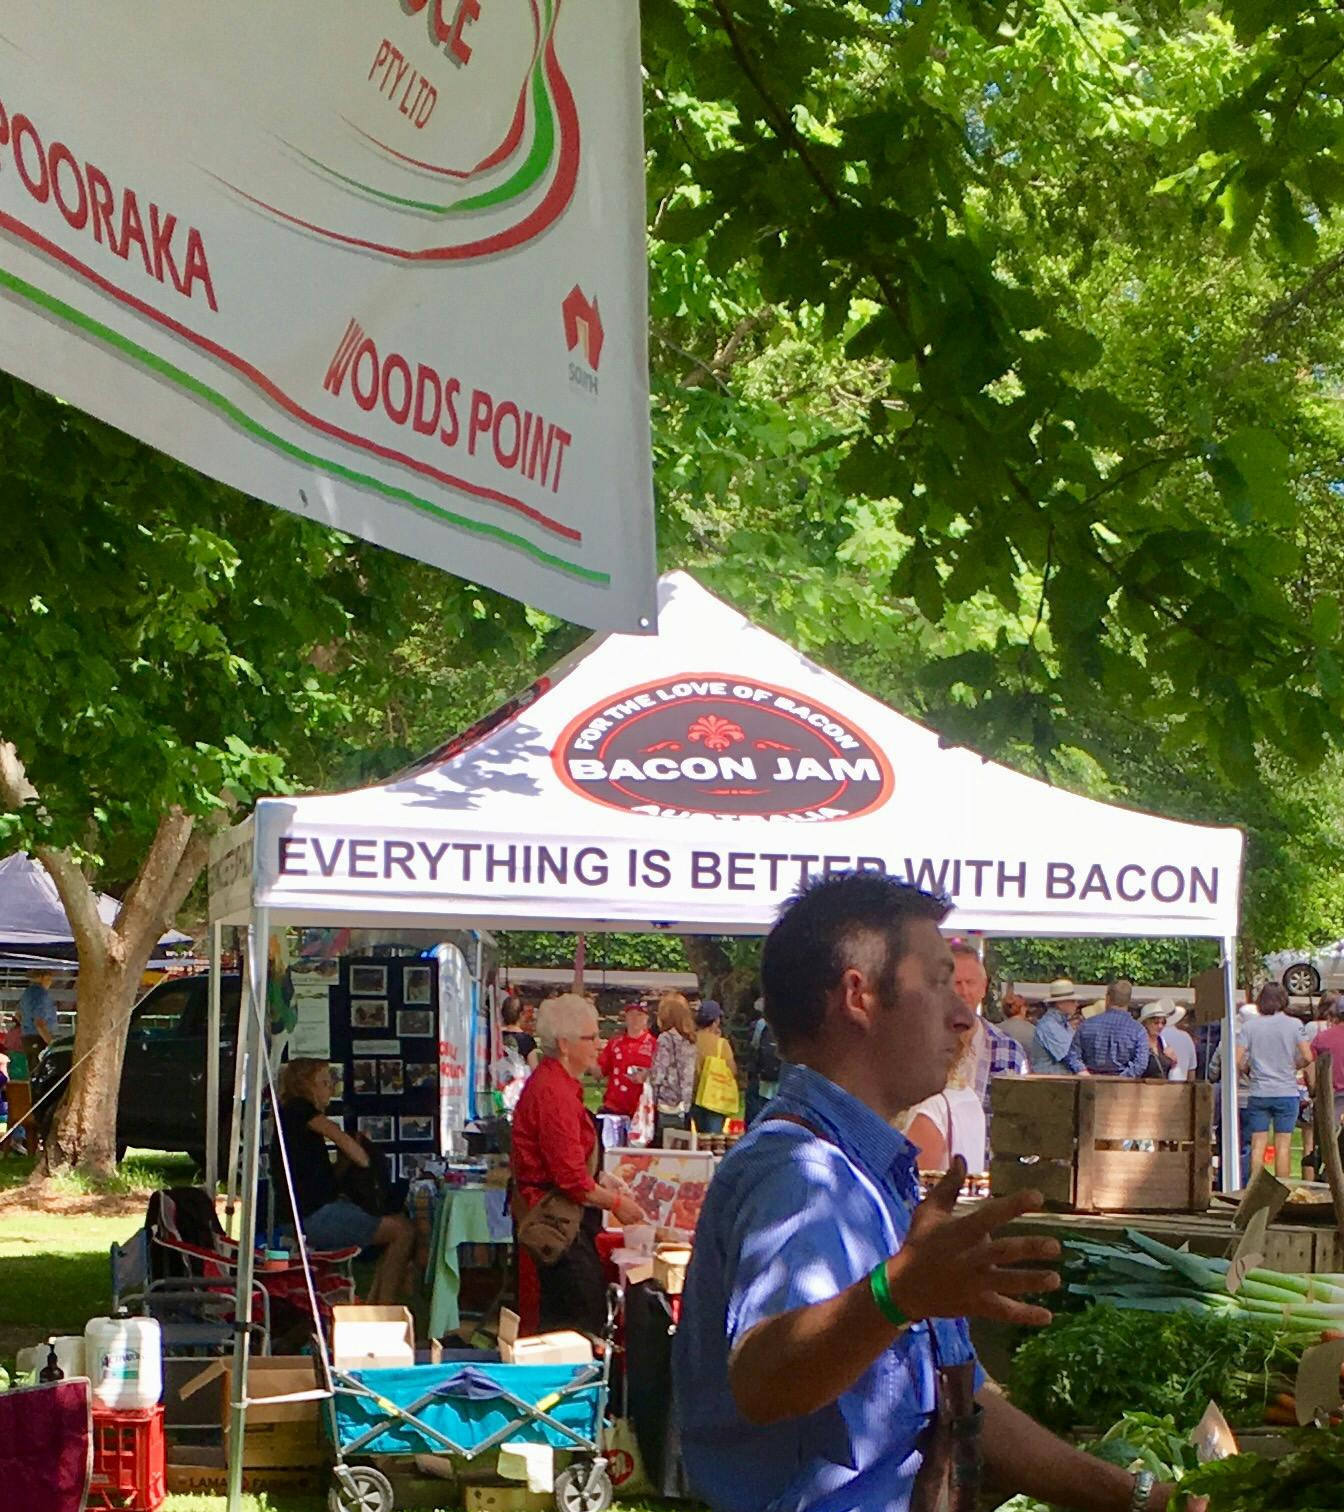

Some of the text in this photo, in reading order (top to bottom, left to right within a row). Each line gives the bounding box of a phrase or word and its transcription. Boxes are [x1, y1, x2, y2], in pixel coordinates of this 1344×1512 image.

[368, 38, 438, 129] PTY LTD
[324, 316, 572, 494] WOODS POINT
[574, 681, 860, 751] FOR THE LOVE OF BACON
[568, 757, 881, 781] BACON JAM
[278, 837, 609, 887] EVERYTHING
[628, 848, 672, 889] IS
[904, 857, 1027, 899] WITH
[1045, 861, 1219, 905] BACON
